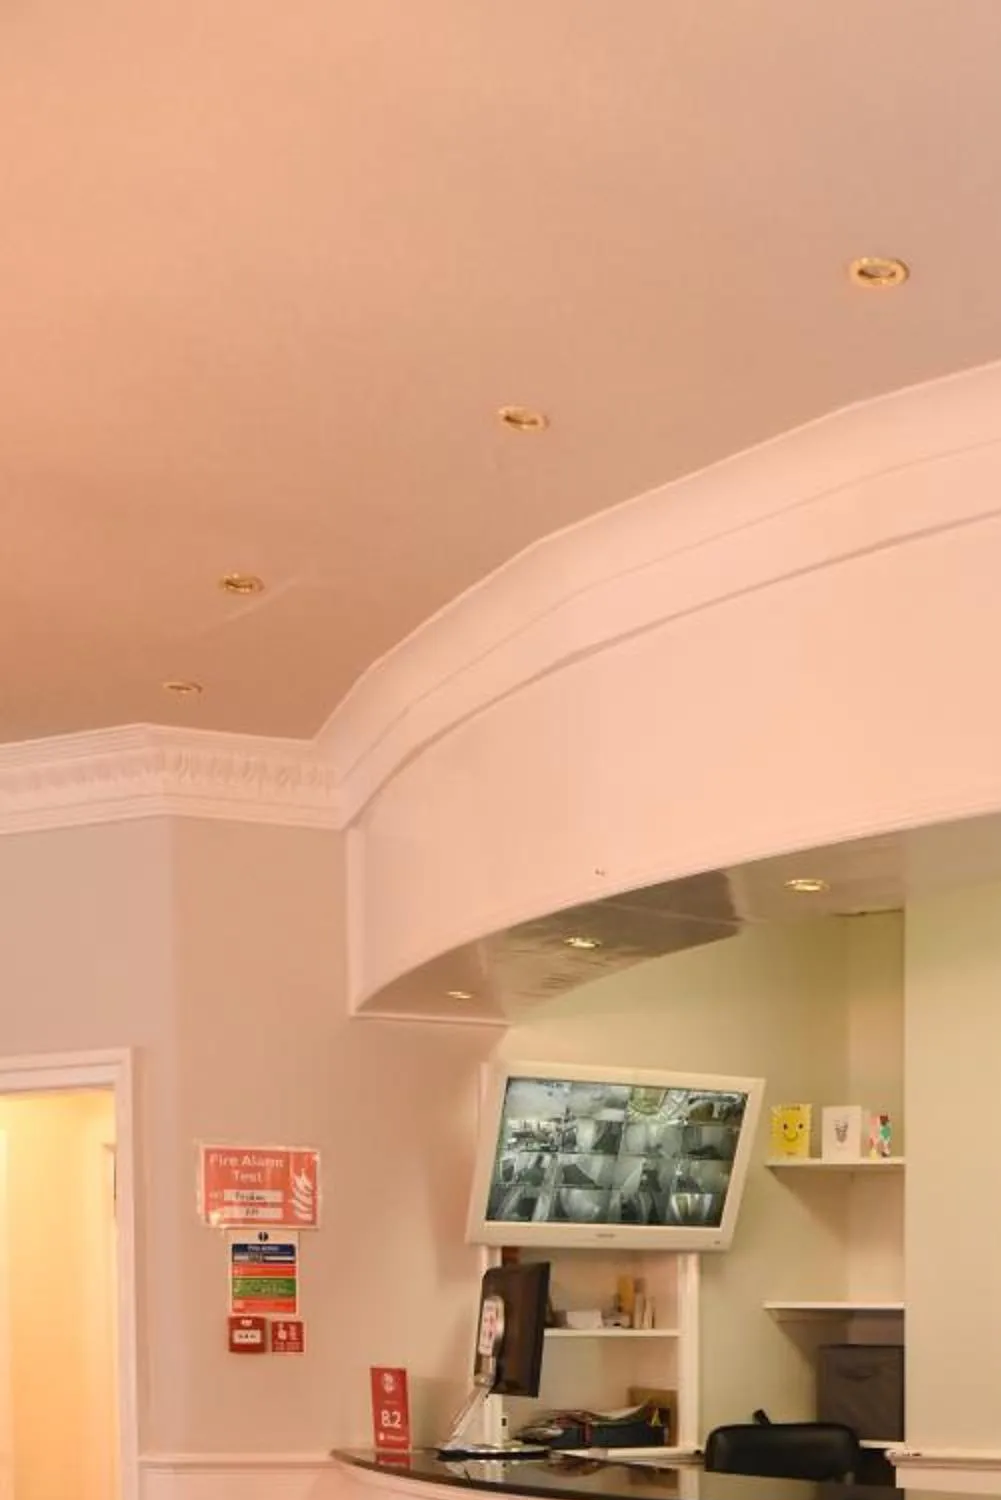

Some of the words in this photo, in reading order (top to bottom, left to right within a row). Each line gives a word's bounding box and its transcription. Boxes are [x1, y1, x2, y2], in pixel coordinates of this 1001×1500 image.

[209, 1153, 239, 1167] Fire
[241, 1153, 284, 1168] Alarm
[232, 1169, 263, 1184] Test
[381, 1409, 402, 1429] B2
